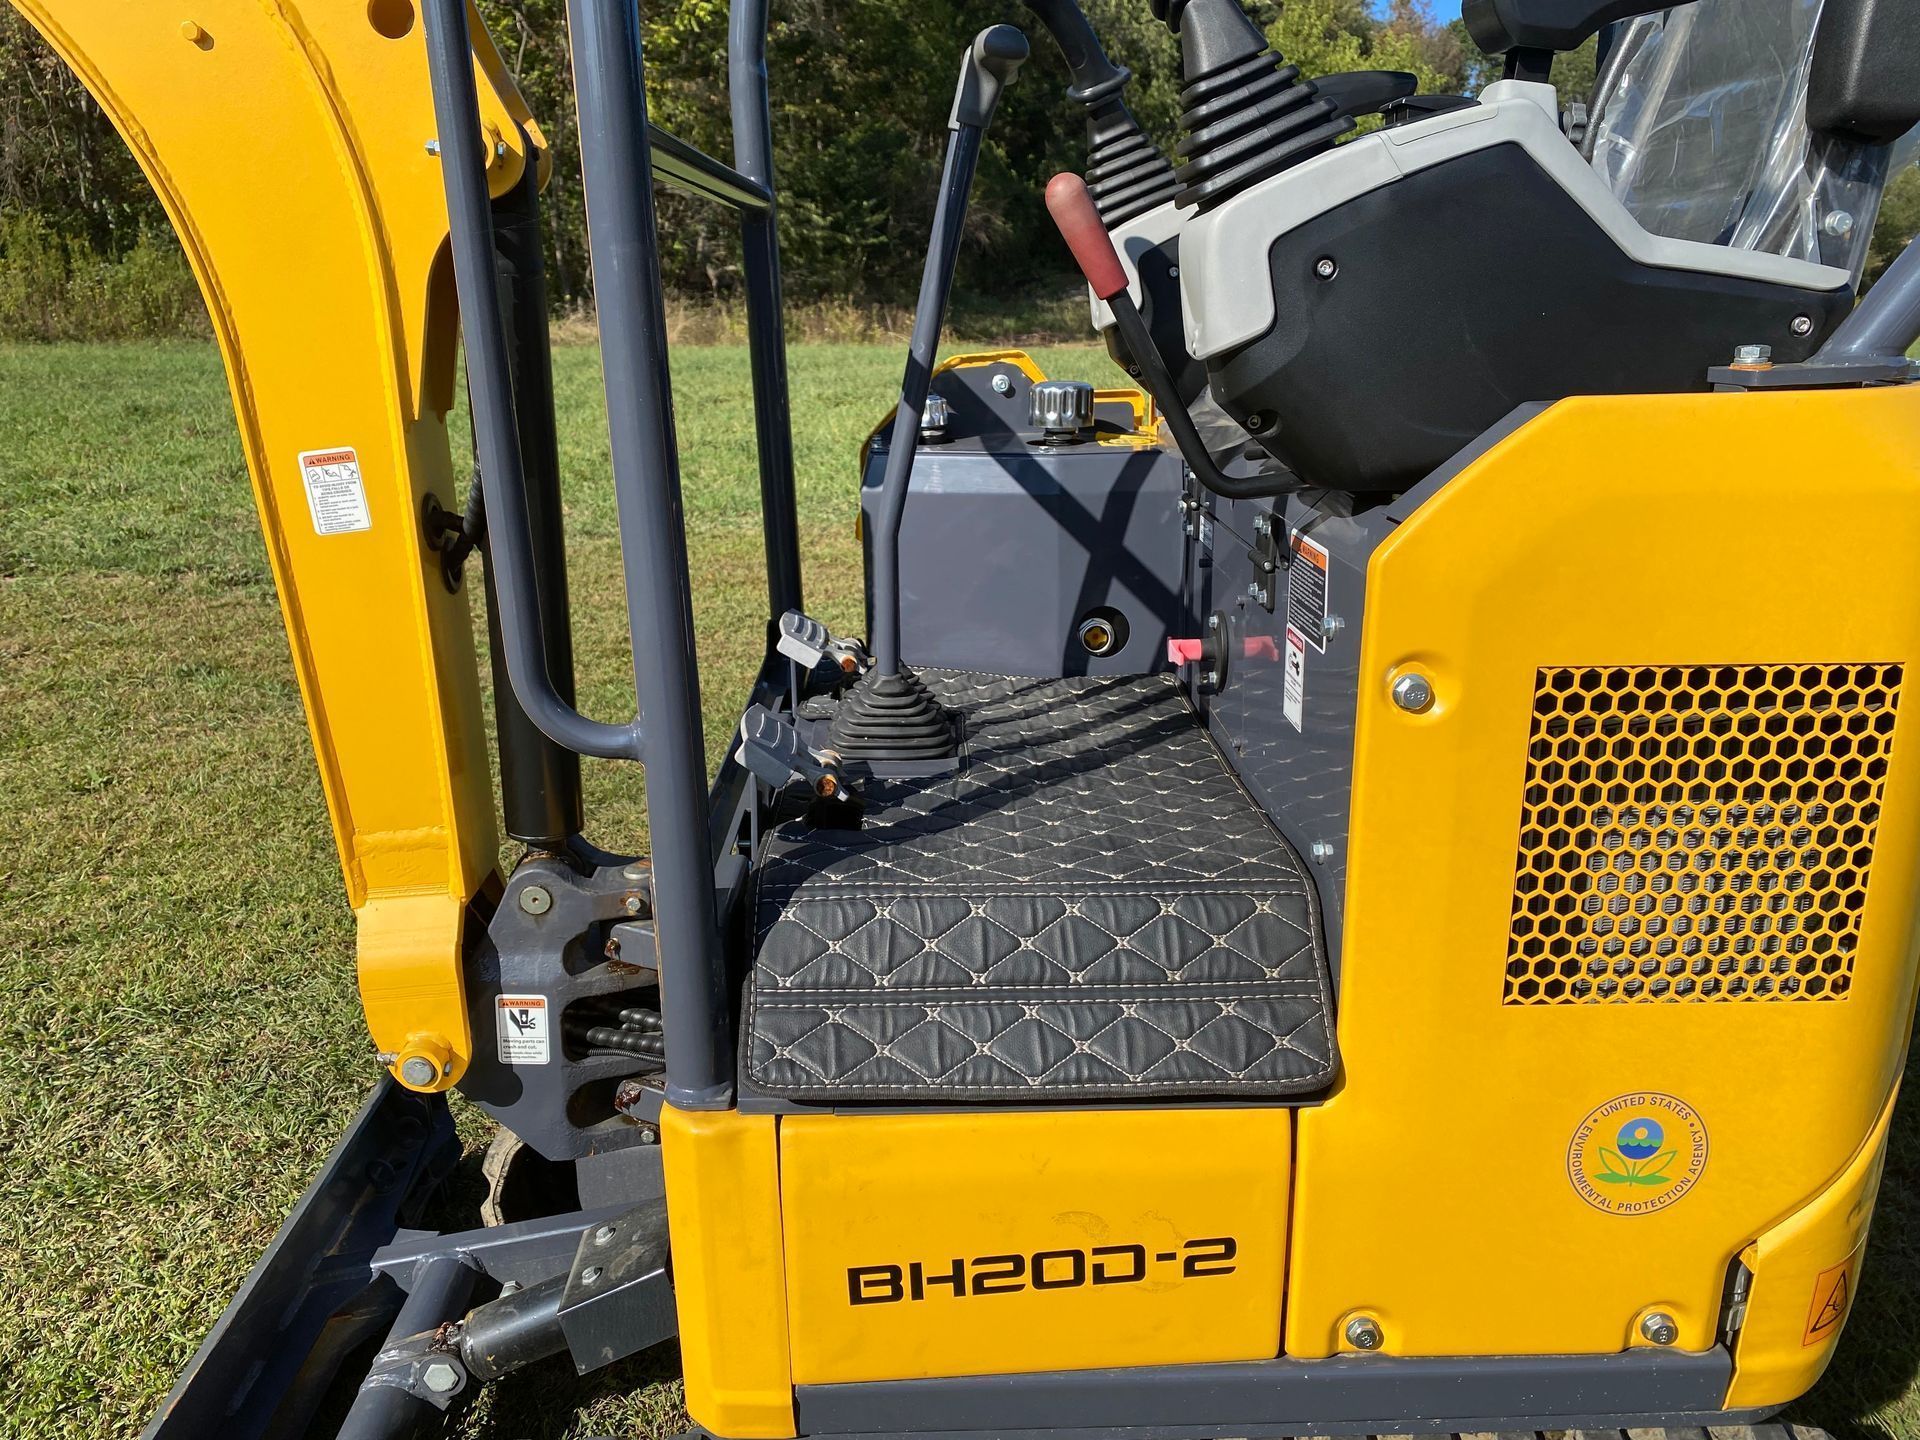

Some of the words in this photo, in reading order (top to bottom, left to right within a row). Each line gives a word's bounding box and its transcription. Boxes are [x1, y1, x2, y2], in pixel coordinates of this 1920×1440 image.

[315, 454, 351, 464] WARNING
[1600, 1096, 1646, 1118] UNITED
[1649, 1096, 1692, 1121] STATES
[1572, 1125, 1613, 1209] ENVIRONMENTAL
[1617, 1177, 1692, 1212] PROTECTION
[1689, 1129, 1704, 1176] AGENCY
[847, 1237, 1238, 1306] BH20D-2
